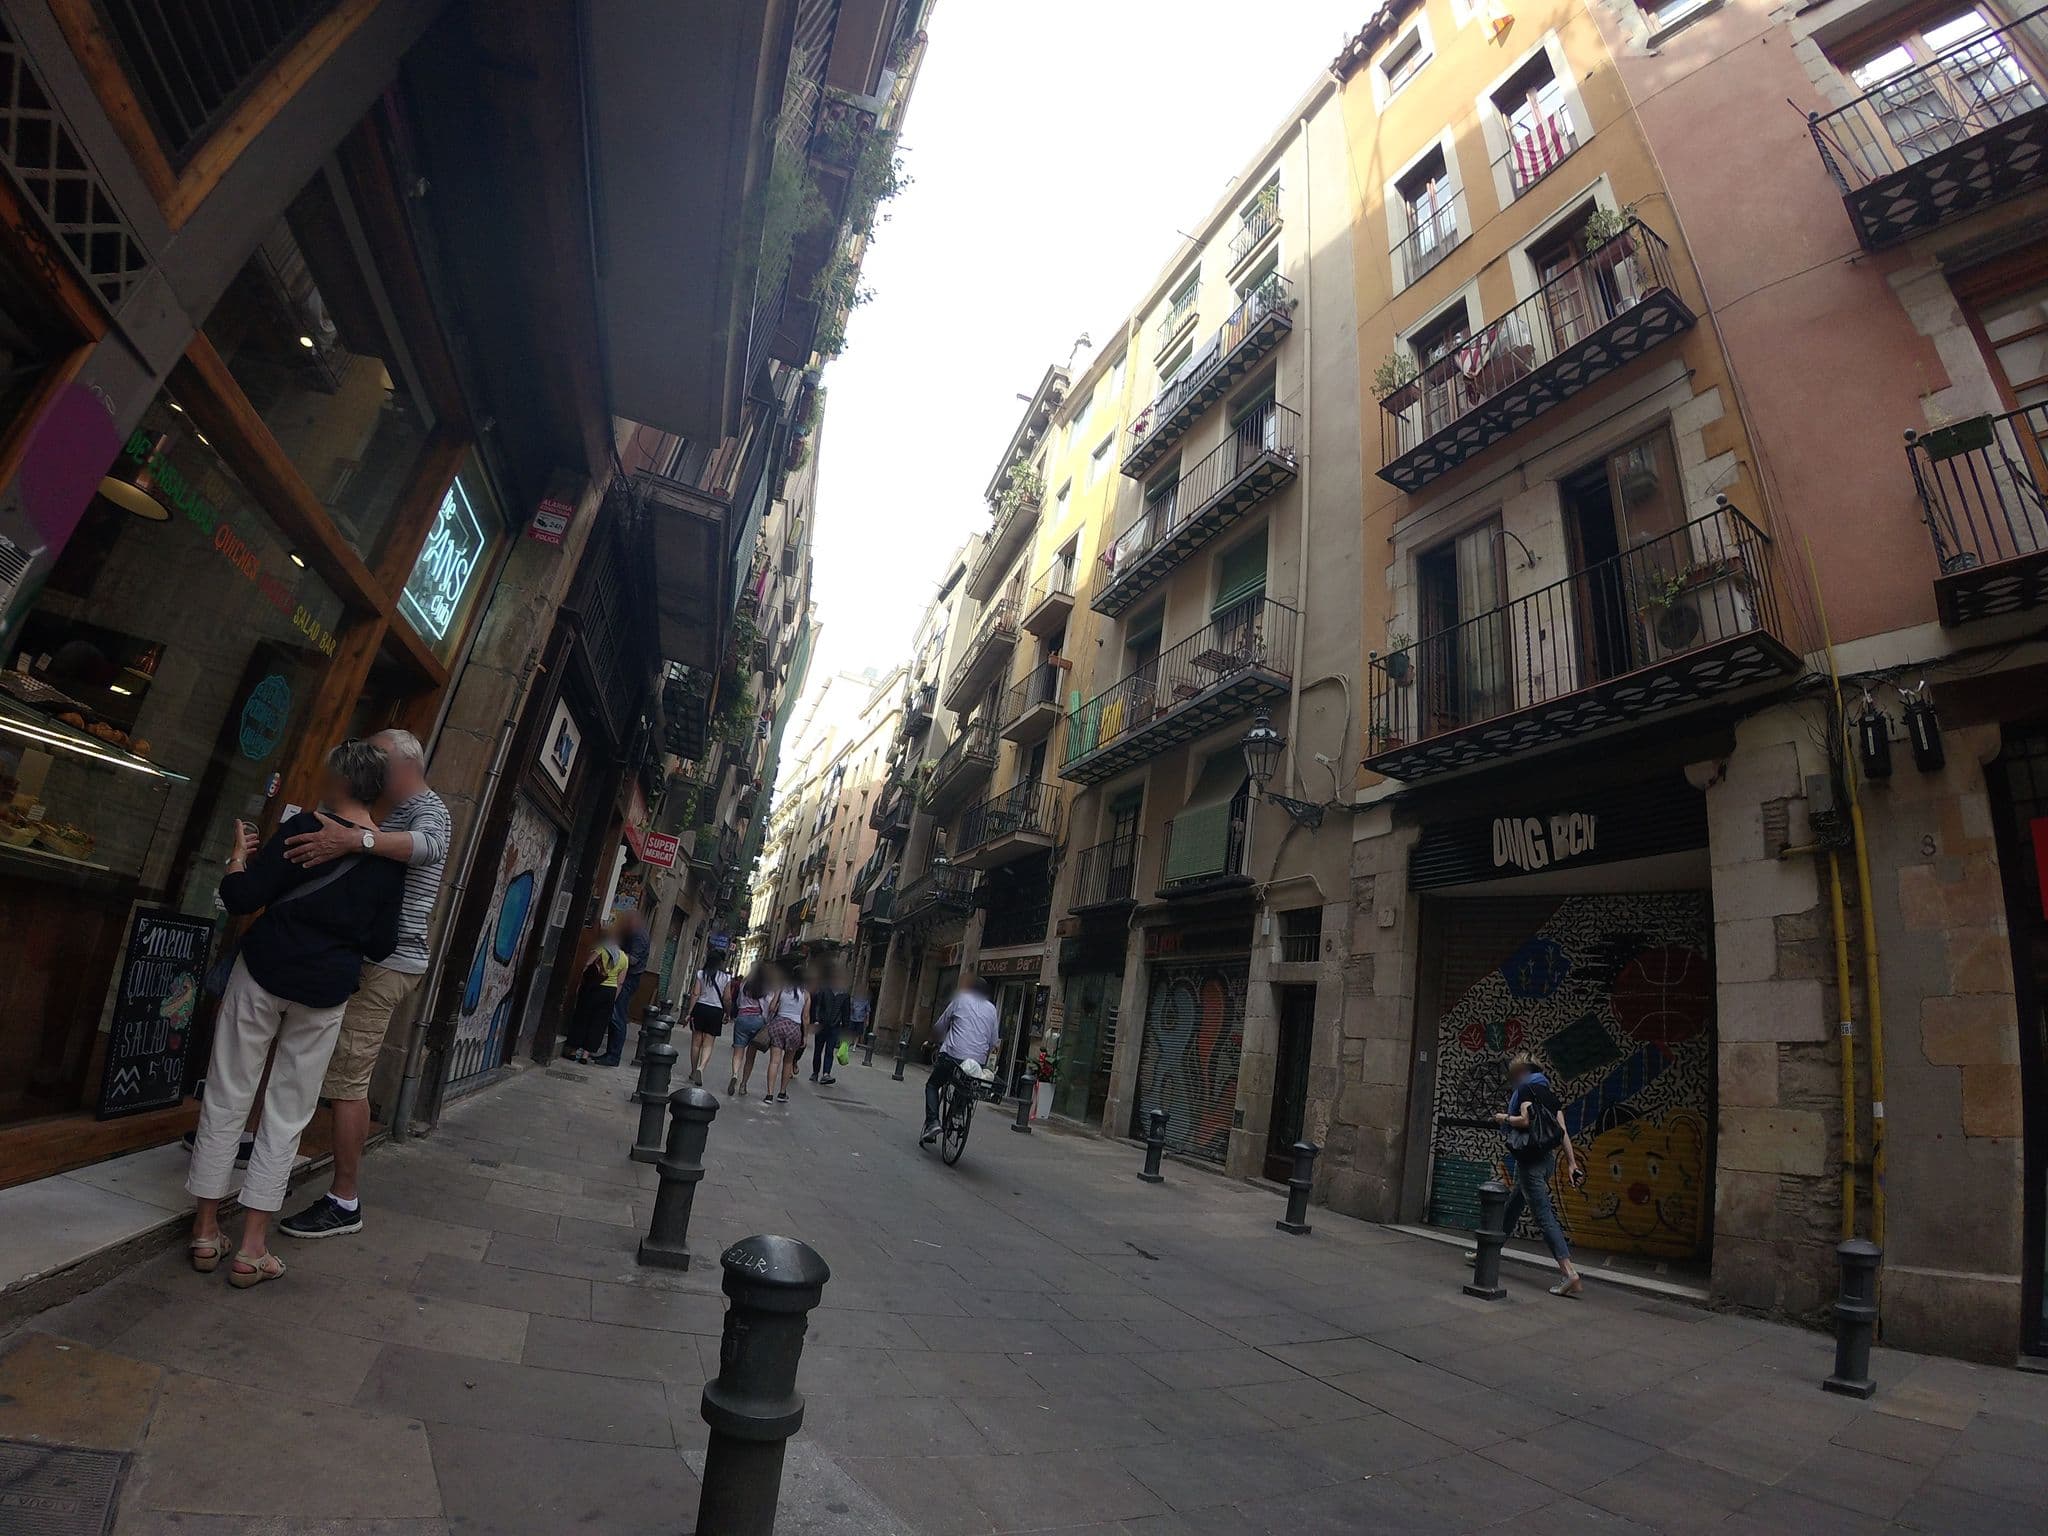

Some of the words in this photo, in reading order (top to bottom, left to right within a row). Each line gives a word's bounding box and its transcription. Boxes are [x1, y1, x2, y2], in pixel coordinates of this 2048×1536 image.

[214, 522, 259, 581] QUICHES
[293, 605, 320, 641] SALAD
[319, 632, 337, 658] BAR
[645, 847, 674, 862] MERCAT
[648, 837, 676, 853] SUPER
[1492, 817, 1550, 871] OMG
[1550, 811, 1596, 861] BCN
[121, 1018, 169, 1057] SALAD
